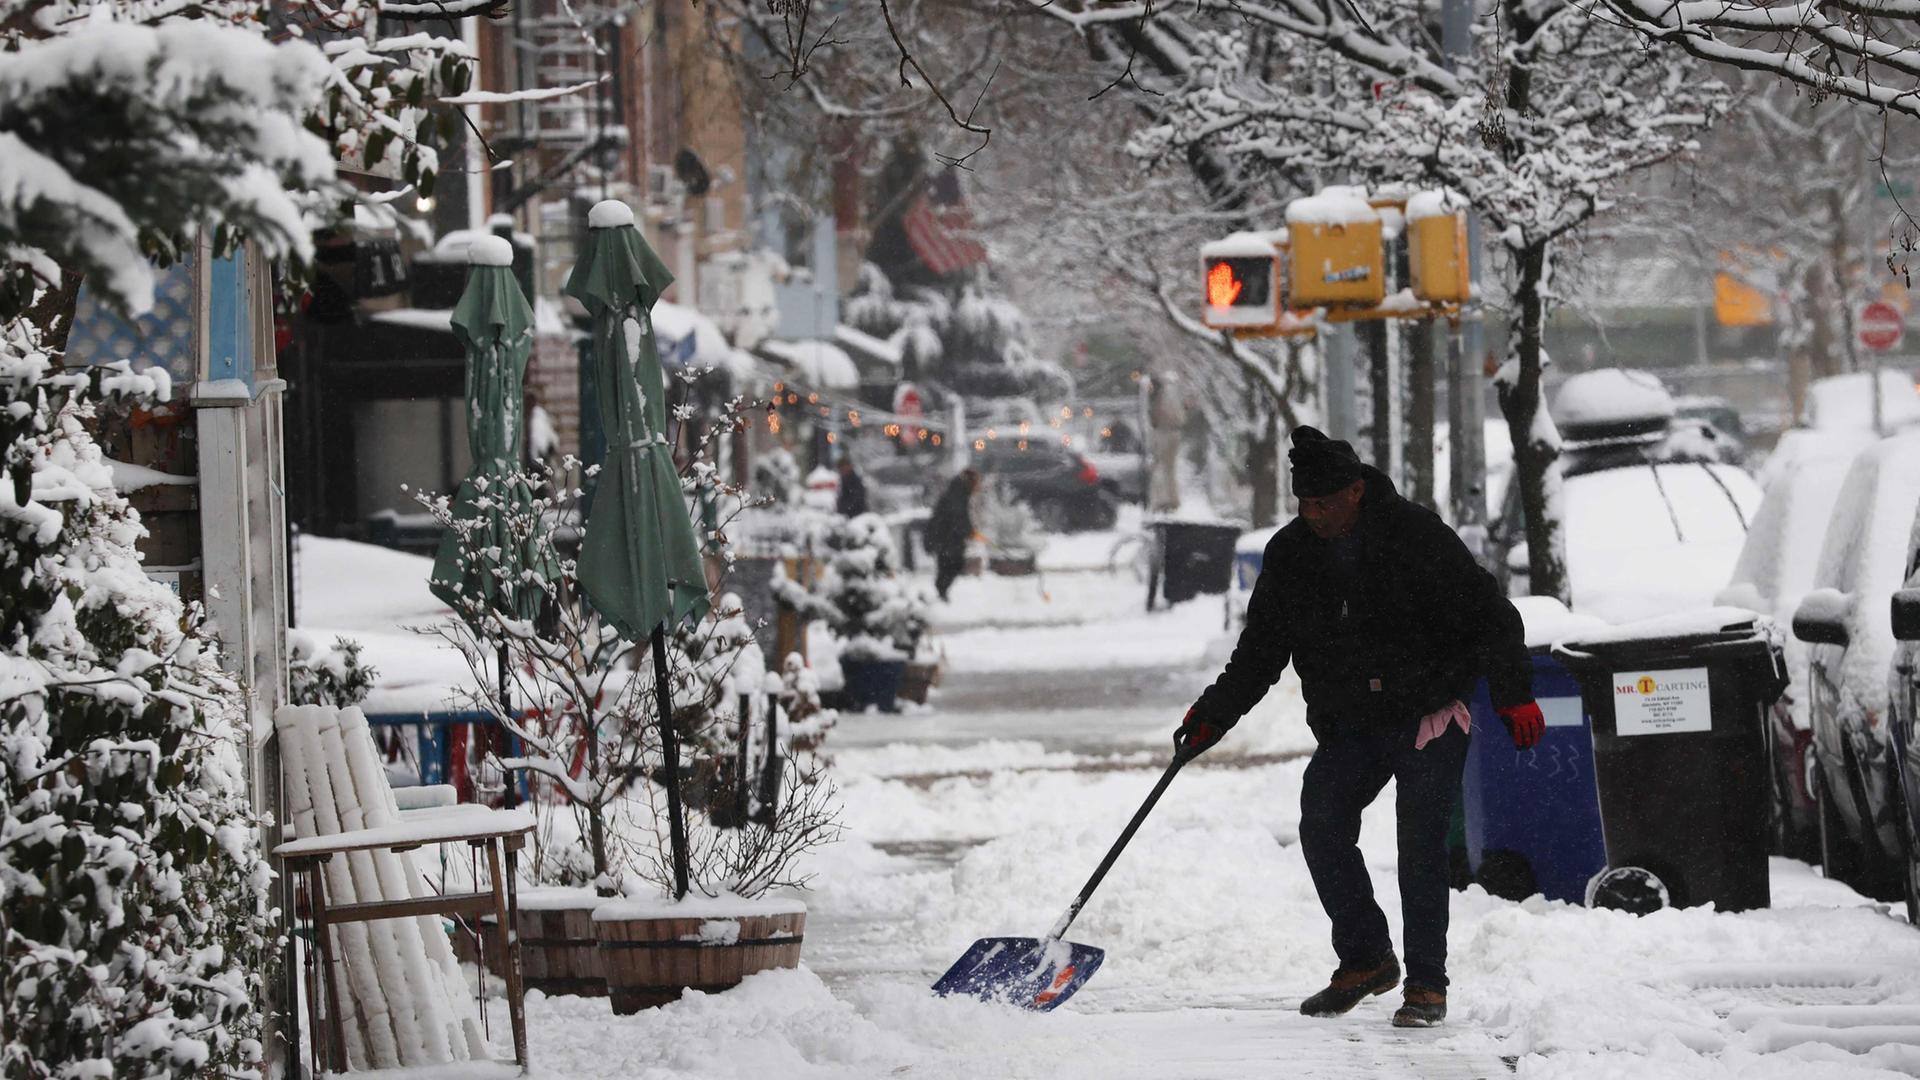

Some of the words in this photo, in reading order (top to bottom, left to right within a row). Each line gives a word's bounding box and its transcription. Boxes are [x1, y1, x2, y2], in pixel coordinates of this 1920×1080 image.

[1616, 685, 1638, 695] MR.
[1640, 679, 1653, 693] T
[1656, 681, 1706, 692] CARTING
